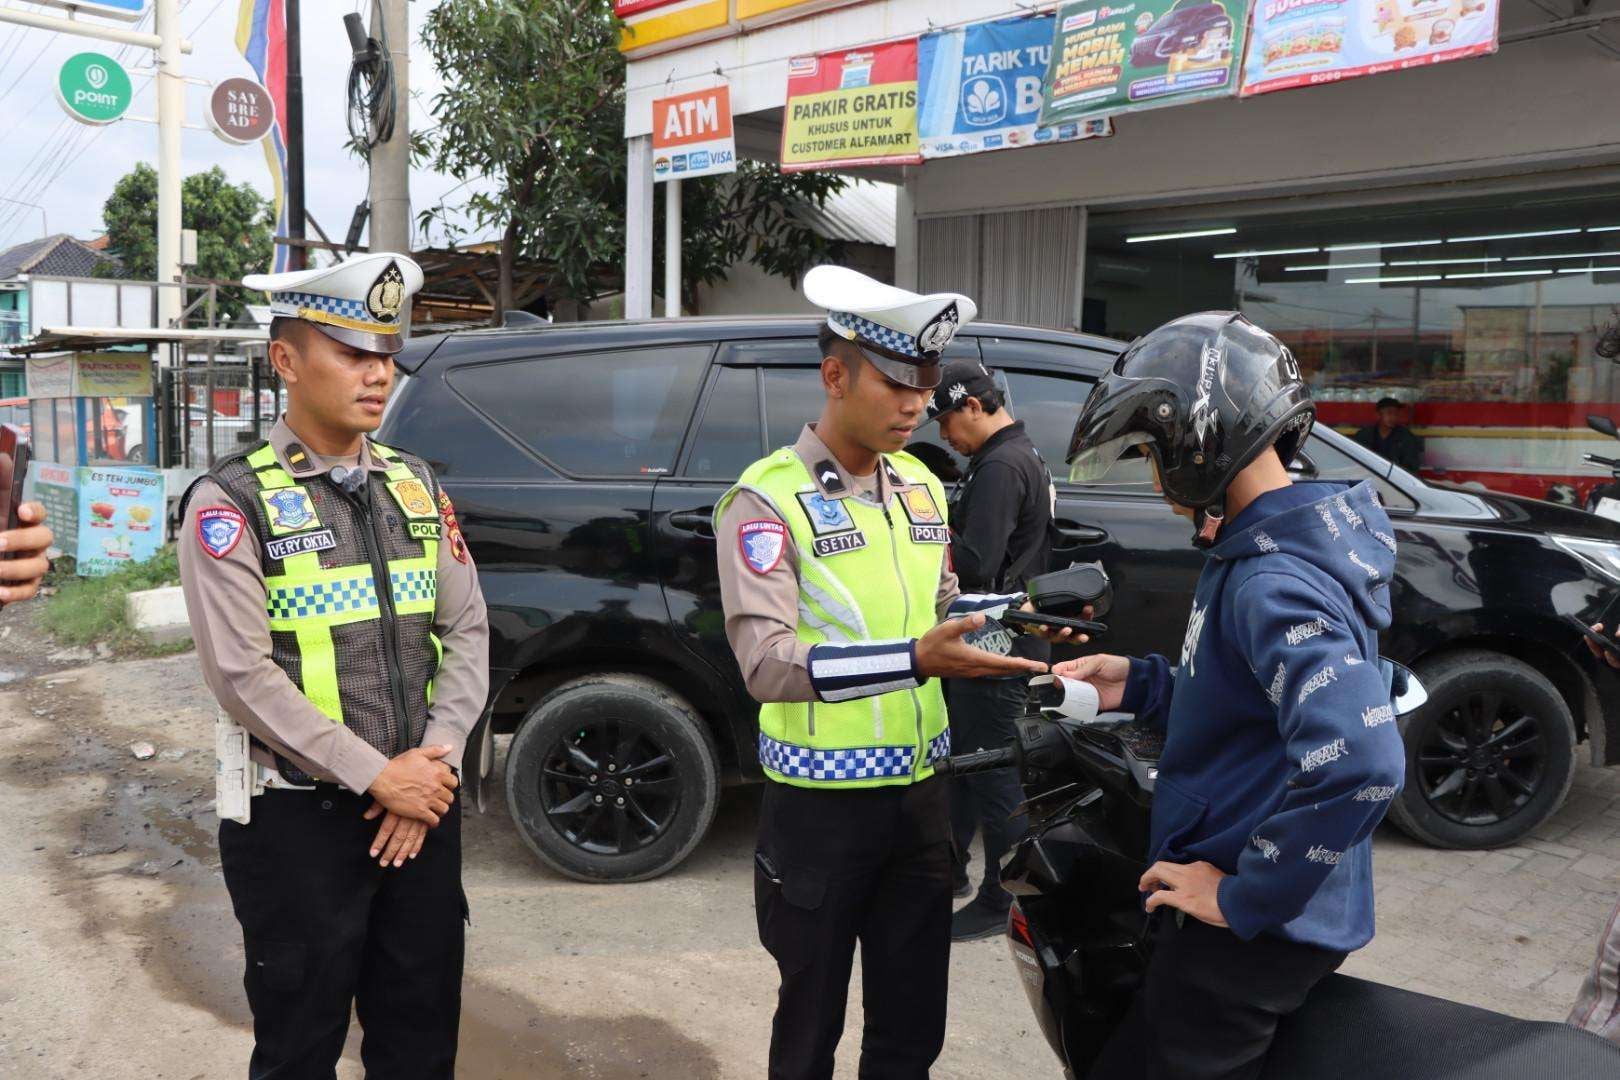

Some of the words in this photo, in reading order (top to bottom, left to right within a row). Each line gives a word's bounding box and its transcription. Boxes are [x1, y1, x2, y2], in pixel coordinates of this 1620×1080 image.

[1063, 34, 1122, 62] MOBIL
[963, 49, 1023, 76] TARIK
[1025, 45, 1053, 66] TU
[227, 90, 258, 104] SAY
[793, 97, 848, 121] PARKIR
[853, 90, 916, 113] GRATIS
[227, 102, 259, 118] BRE
[663, 95, 718, 140] ATM
[226, 116, 250, 128] AD
[808, 120, 849, 136] KHUSUS
[852, 116, 893, 131] UNTUK
[791, 138, 847, 154] CUSTOMER
[850, 133, 912, 149] ALFAMART
[710, 151, 733, 165] VISA
[91, 472, 104, 482] ES
[106, 474, 123, 483] TEH
[125, 475, 158, 486] JUMBO
[201, 510, 218, 518] LALU
[742, 522, 758, 532] LALU
[759, 522, 784, 533] LINTAS
[915, 528, 946, 541] POLRI
[270, 539, 301, 556] VERY
[303, 533, 331, 549] OKTA
[820, 534, 862, 552] SETYA
